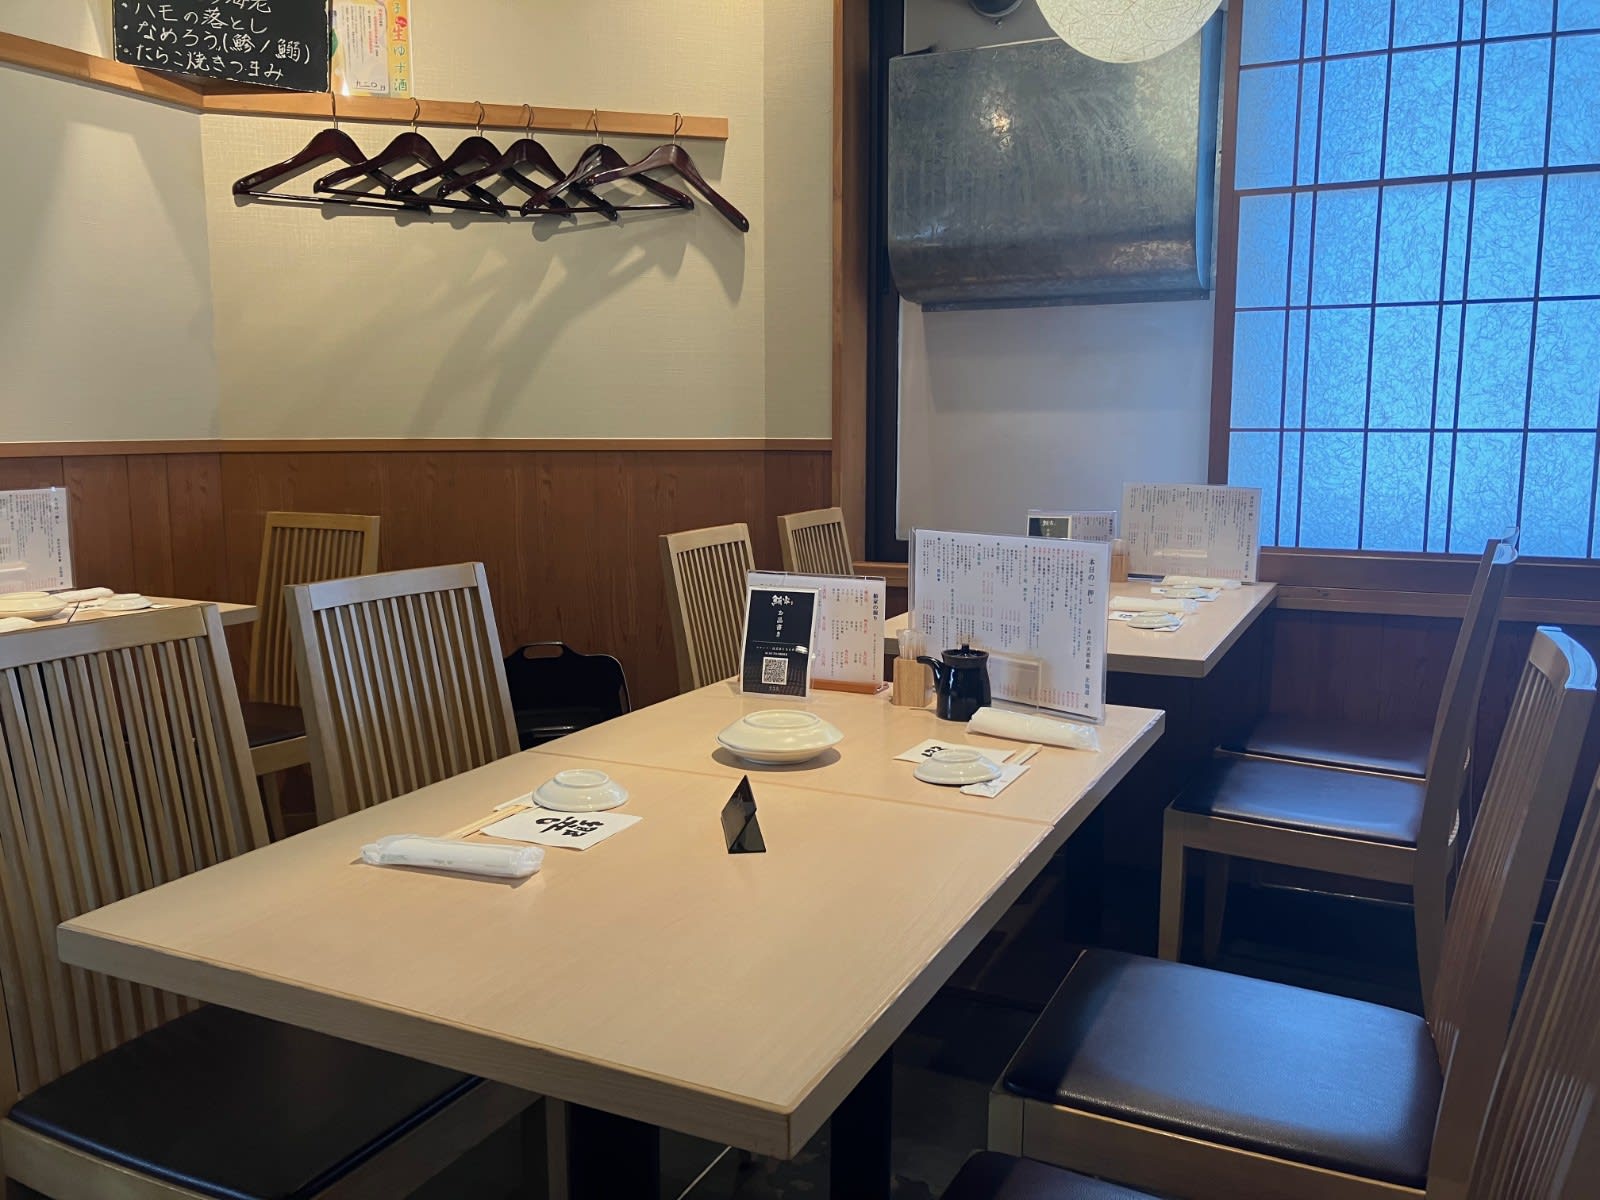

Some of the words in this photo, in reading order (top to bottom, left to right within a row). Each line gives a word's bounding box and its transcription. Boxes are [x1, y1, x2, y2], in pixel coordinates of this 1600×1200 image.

[134, 3, 269, 35] ハモの落とし
[135, 44, 285, 82] たらこ焼きつまみ
